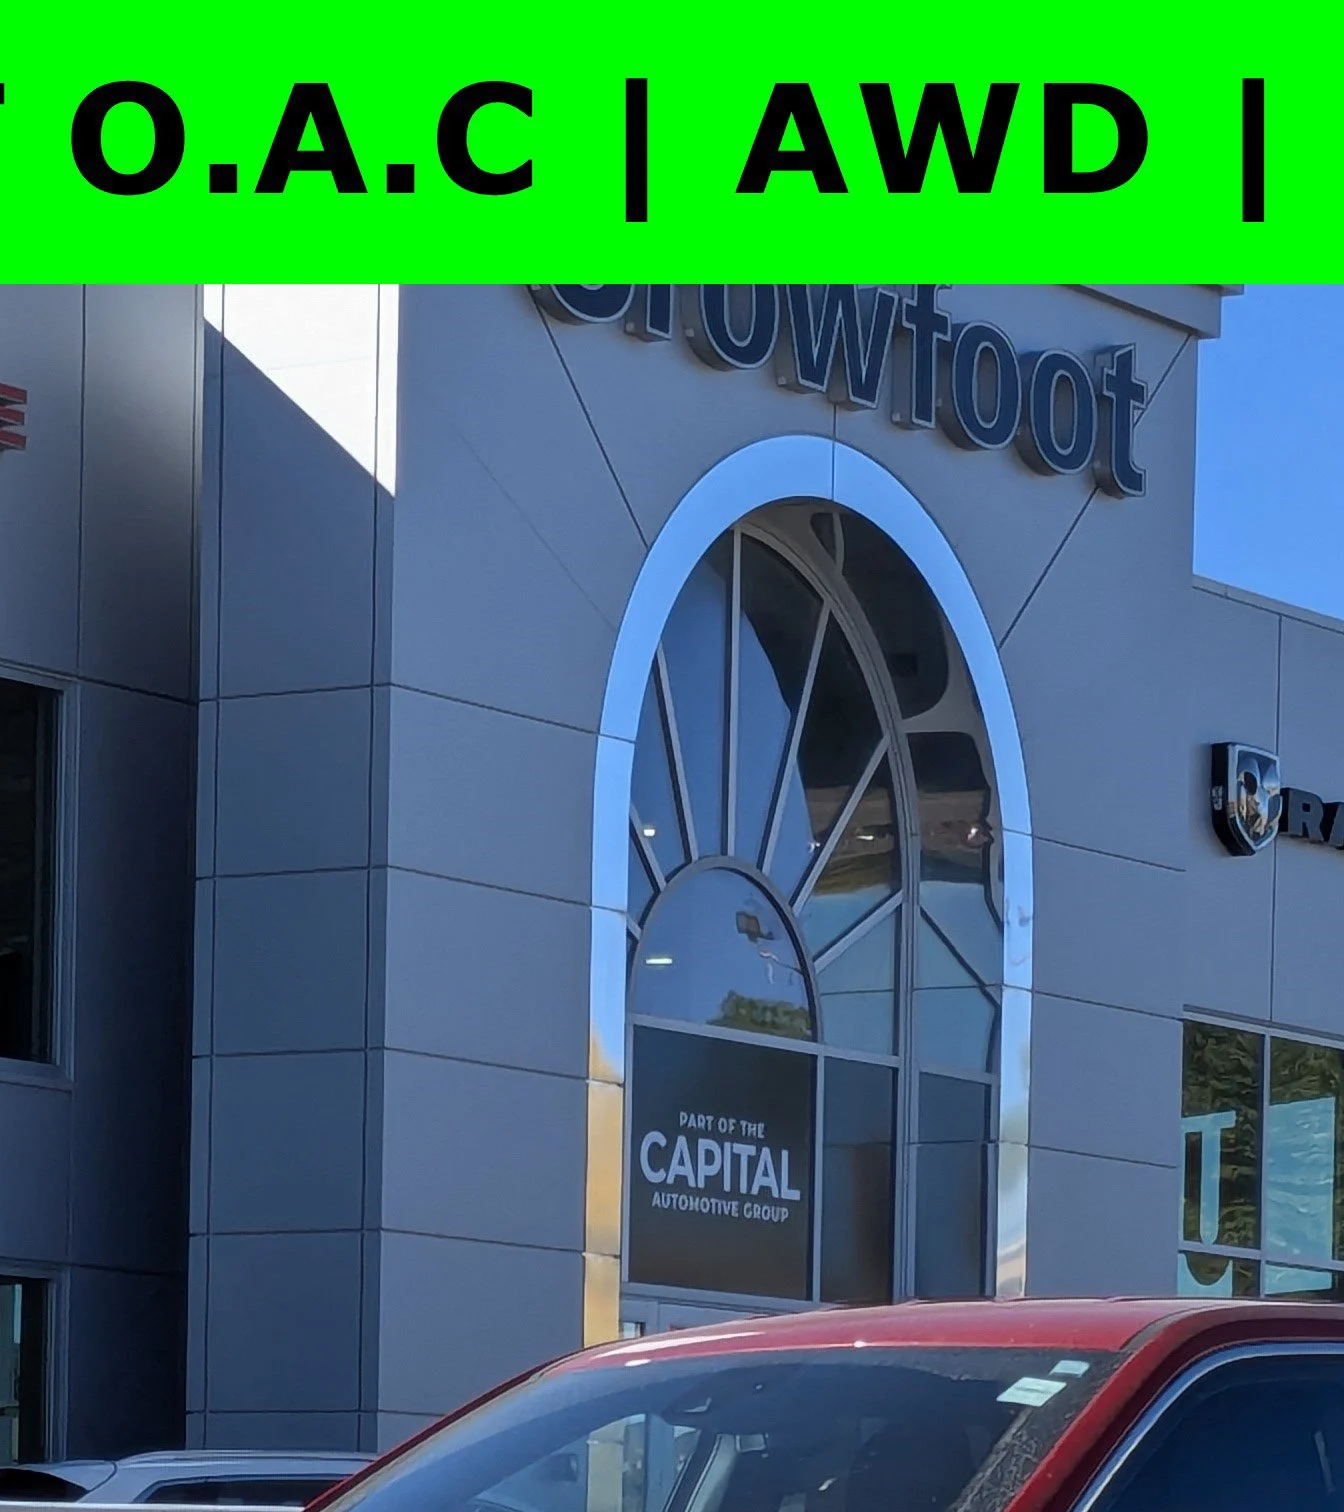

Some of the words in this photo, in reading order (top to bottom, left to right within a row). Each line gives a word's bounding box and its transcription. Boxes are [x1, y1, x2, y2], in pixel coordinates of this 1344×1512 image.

[538, 284, 1147, 498] owfoot
[679, 1111, 714, 1131] PART
[717, 1116, 737, 1134] OF
[740, 1119, 765, 1138] THE
[639, 1130, 801, 1201] CAPITAL
[652, 1191, 739, 1218] AUTOMOTIVE
[743, 1202, 789, 1223] GROUP
